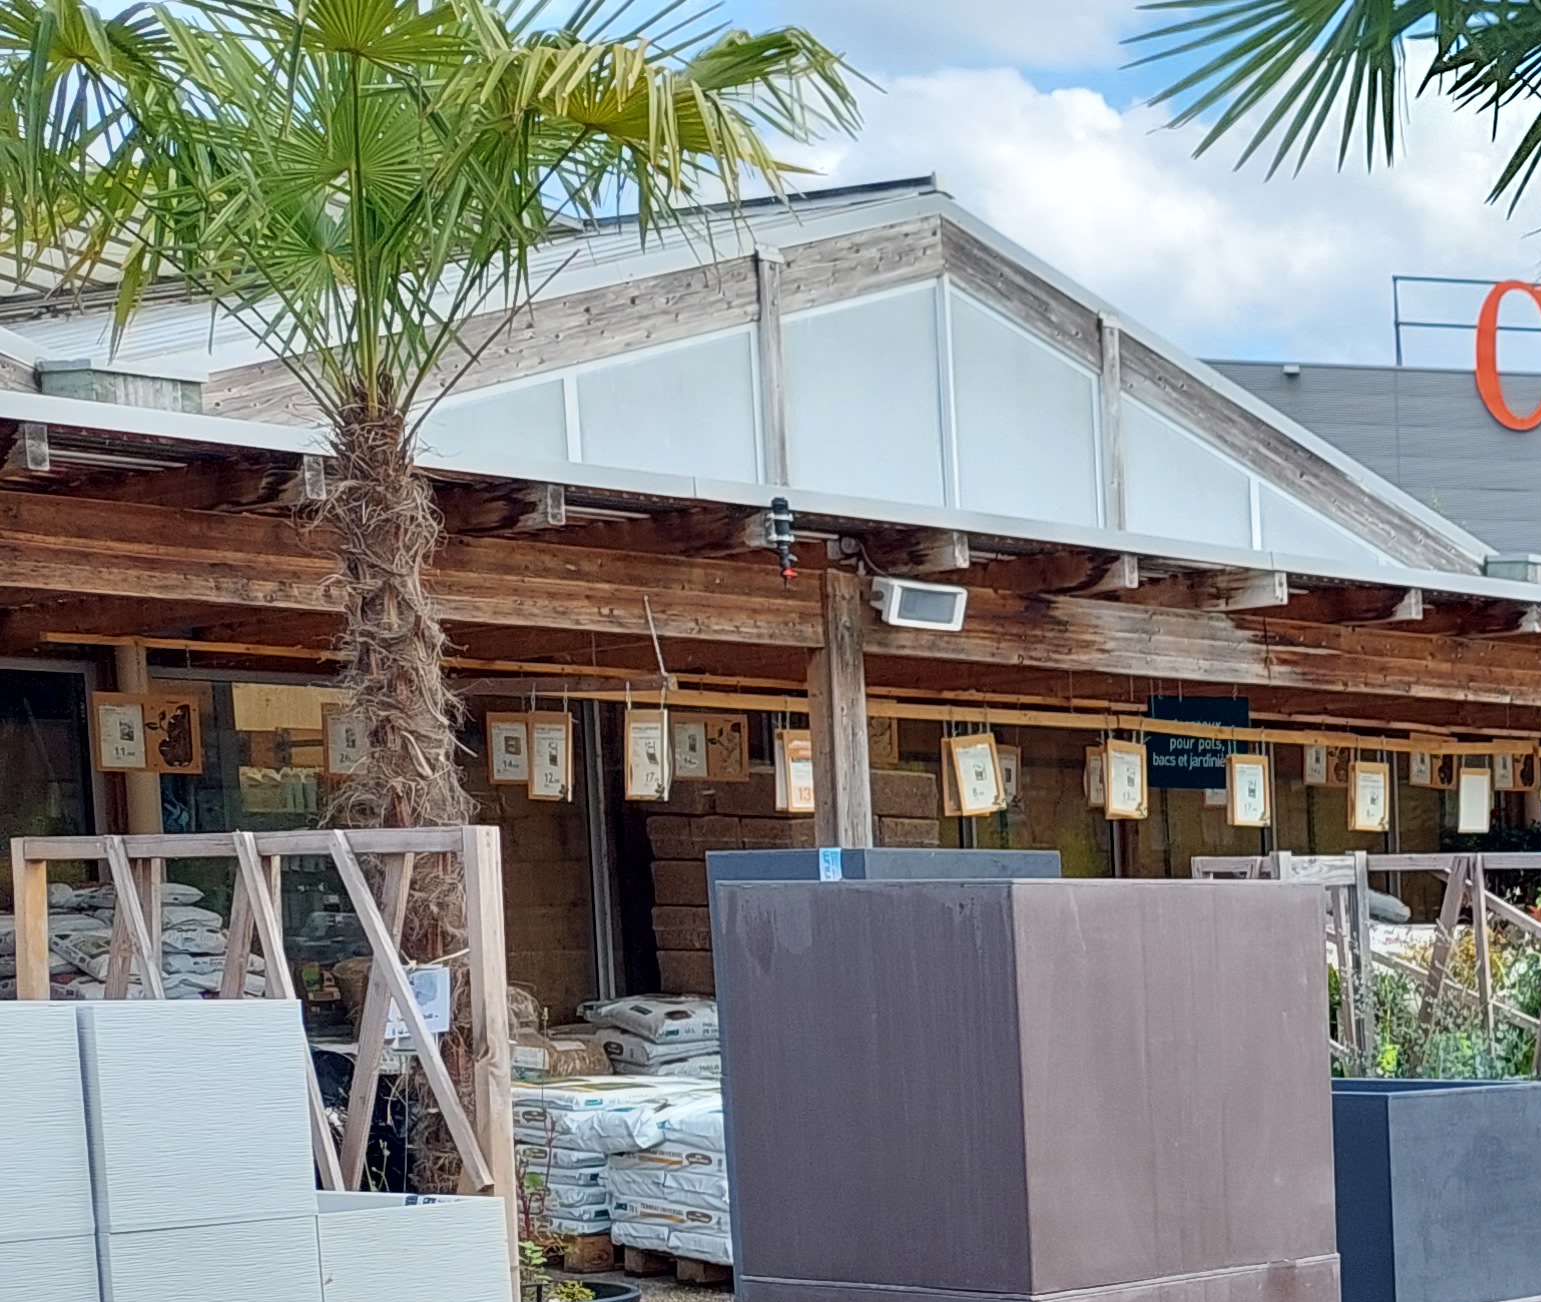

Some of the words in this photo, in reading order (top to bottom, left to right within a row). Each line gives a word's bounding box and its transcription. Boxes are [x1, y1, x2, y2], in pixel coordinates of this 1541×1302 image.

[1169, 738, 1196, 752] pour
[1152, 752, 1177, 767] bacs
[1177, 753, 1188, 767] et
